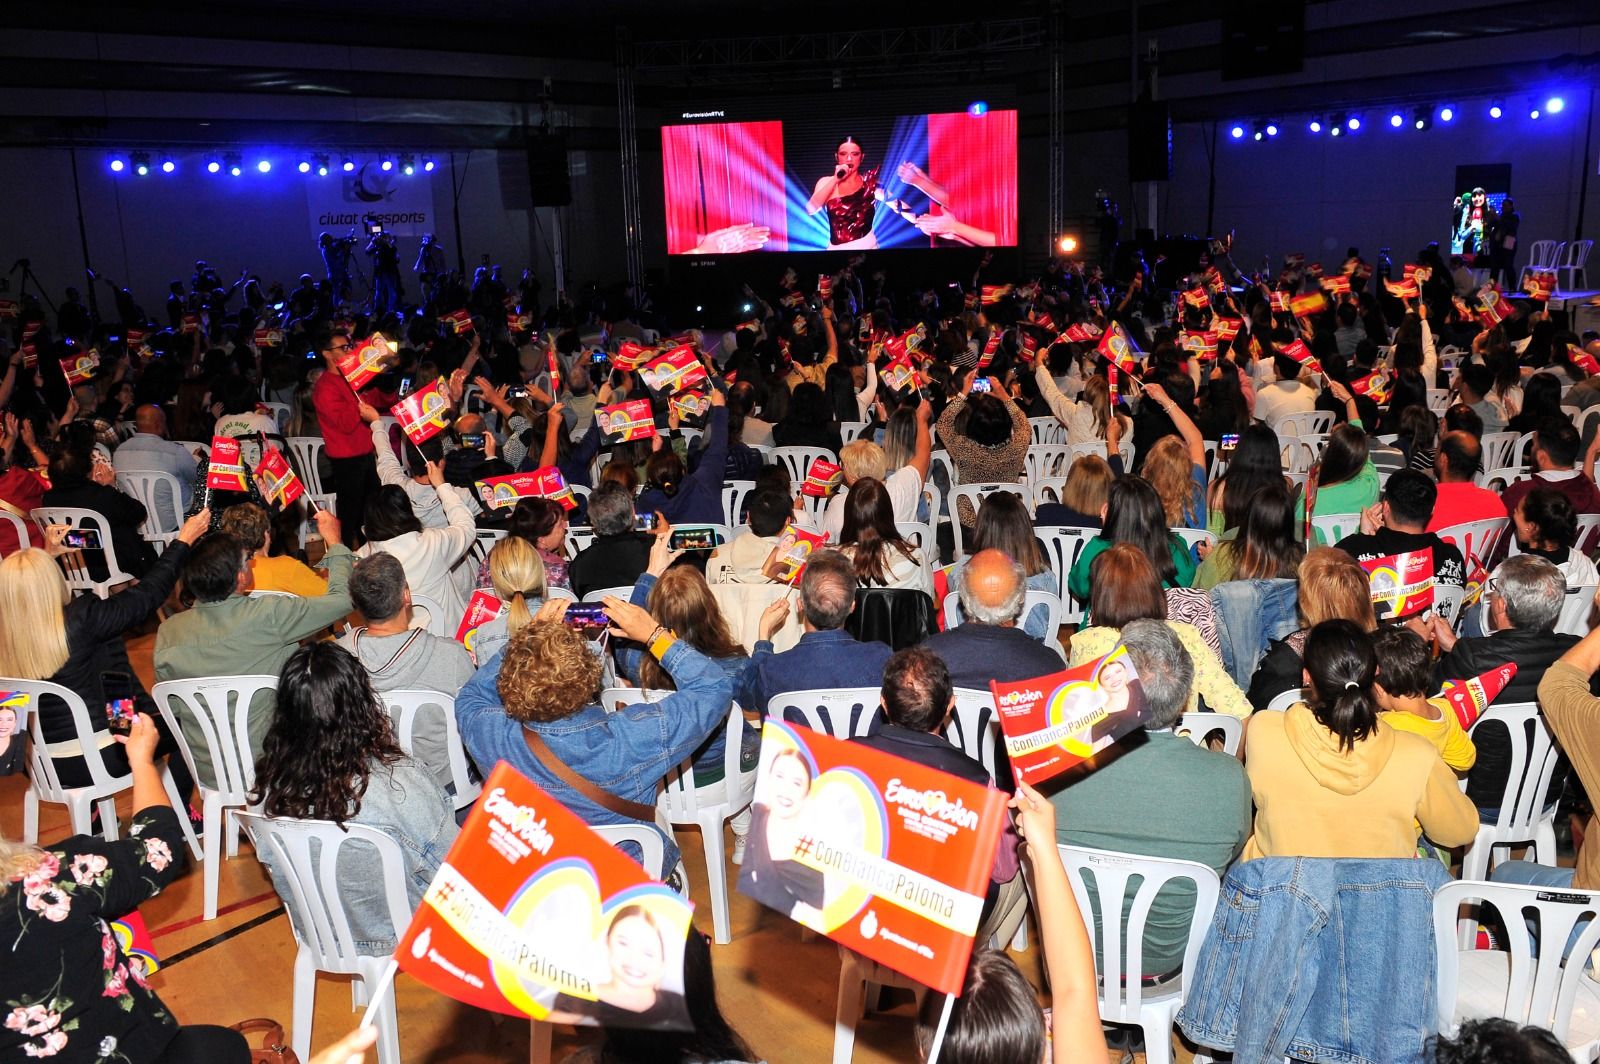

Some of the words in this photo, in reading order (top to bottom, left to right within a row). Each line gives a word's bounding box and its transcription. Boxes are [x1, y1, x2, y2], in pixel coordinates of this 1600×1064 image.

[319, 212, 359, 225] ciutat
[235, 421, 249, 432] and
[884, 777, 979, 832] Eurovision
[794, 834, 956, 919] #ConBlancaPaloma
[1538, 891, 1553, 901] ET
